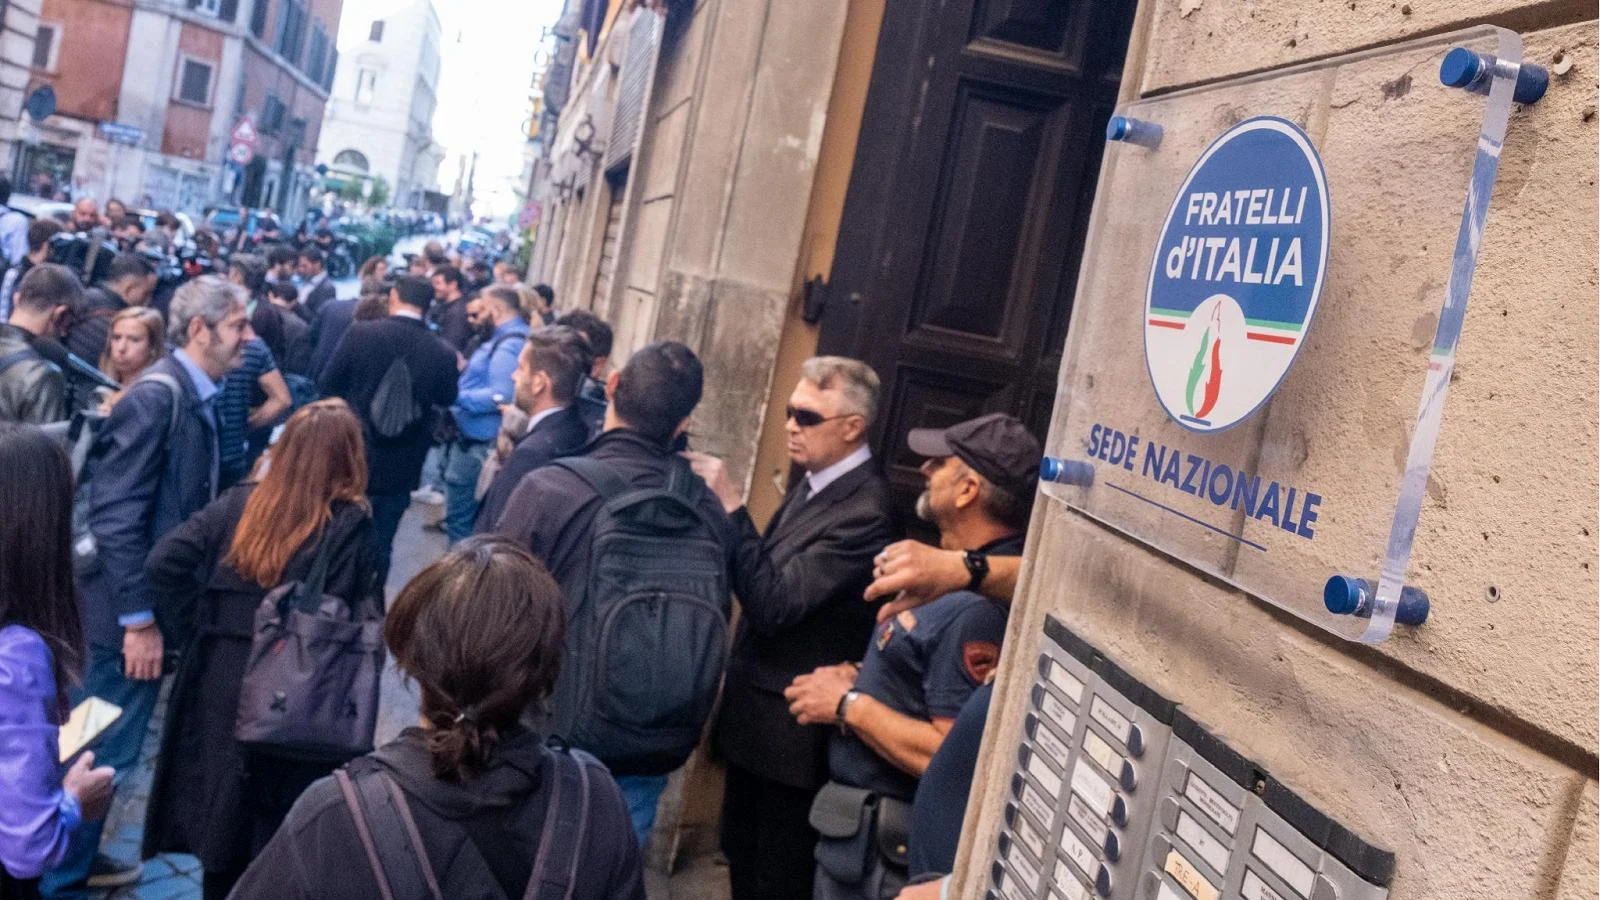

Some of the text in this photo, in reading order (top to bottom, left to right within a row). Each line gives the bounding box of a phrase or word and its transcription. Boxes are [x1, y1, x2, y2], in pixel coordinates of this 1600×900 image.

[1184, 186, 1308, 226] FRATELLI
[1165, 235, 1304, 287] d'ITALIA
[1086, 423, 1322, 540] SEDE NAZIONALE
